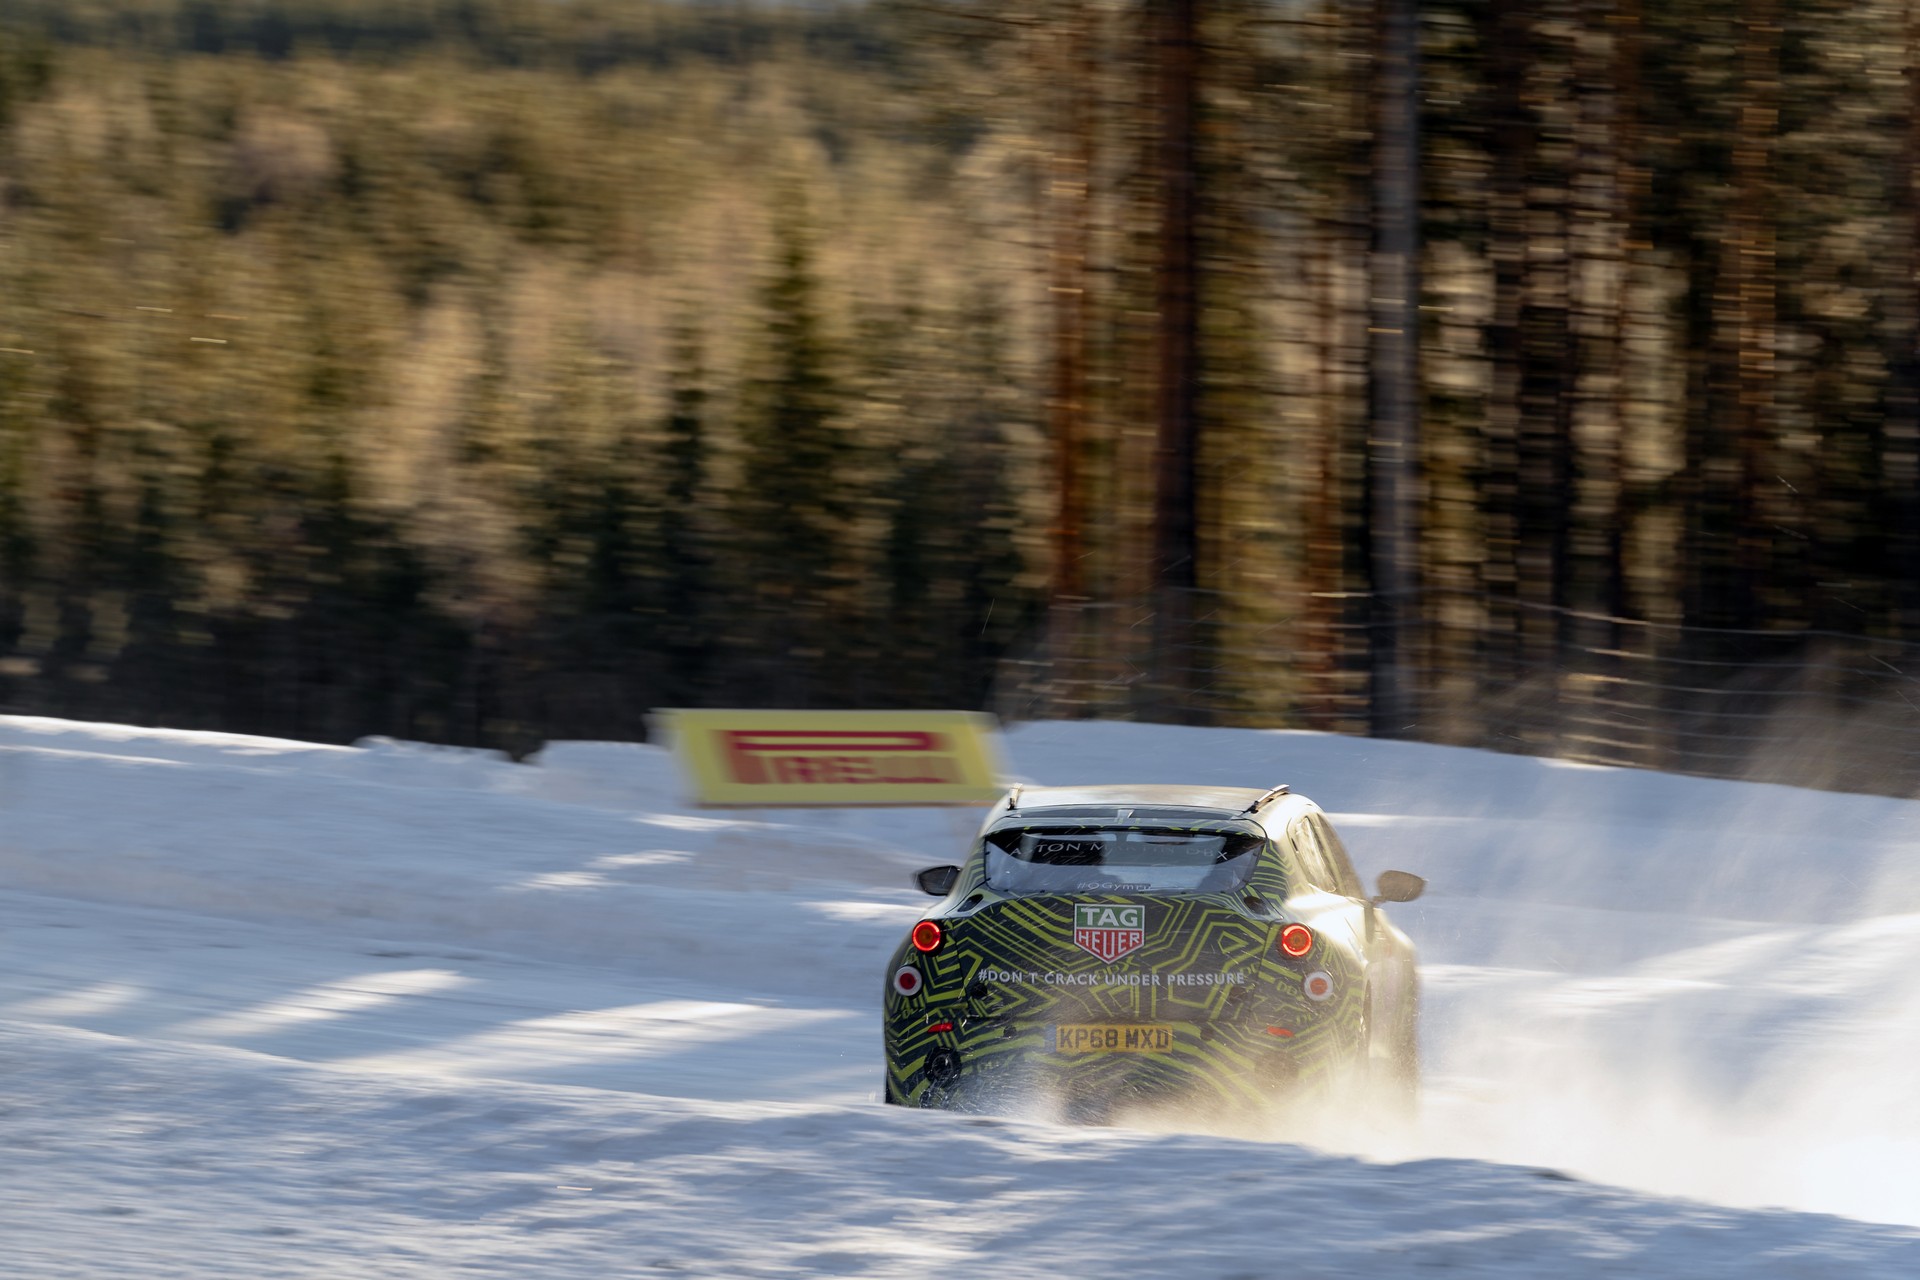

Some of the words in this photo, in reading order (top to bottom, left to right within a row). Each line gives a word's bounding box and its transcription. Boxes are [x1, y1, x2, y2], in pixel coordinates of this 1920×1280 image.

[1009, 842, 1081, 857] ATON
[1080, 907, 1138, 927] TAG
[1078, 930, 1140, 959] HEUER
[1044, 973, 1098, 986] CRACK
[1105, 974, 1160, 986] UNDER
[1167, 972, 1245, 986] PRESSURE
[1060, 1028, 1118, 1049] KP68
[1125, 1028, 1169, 1049] MXD
